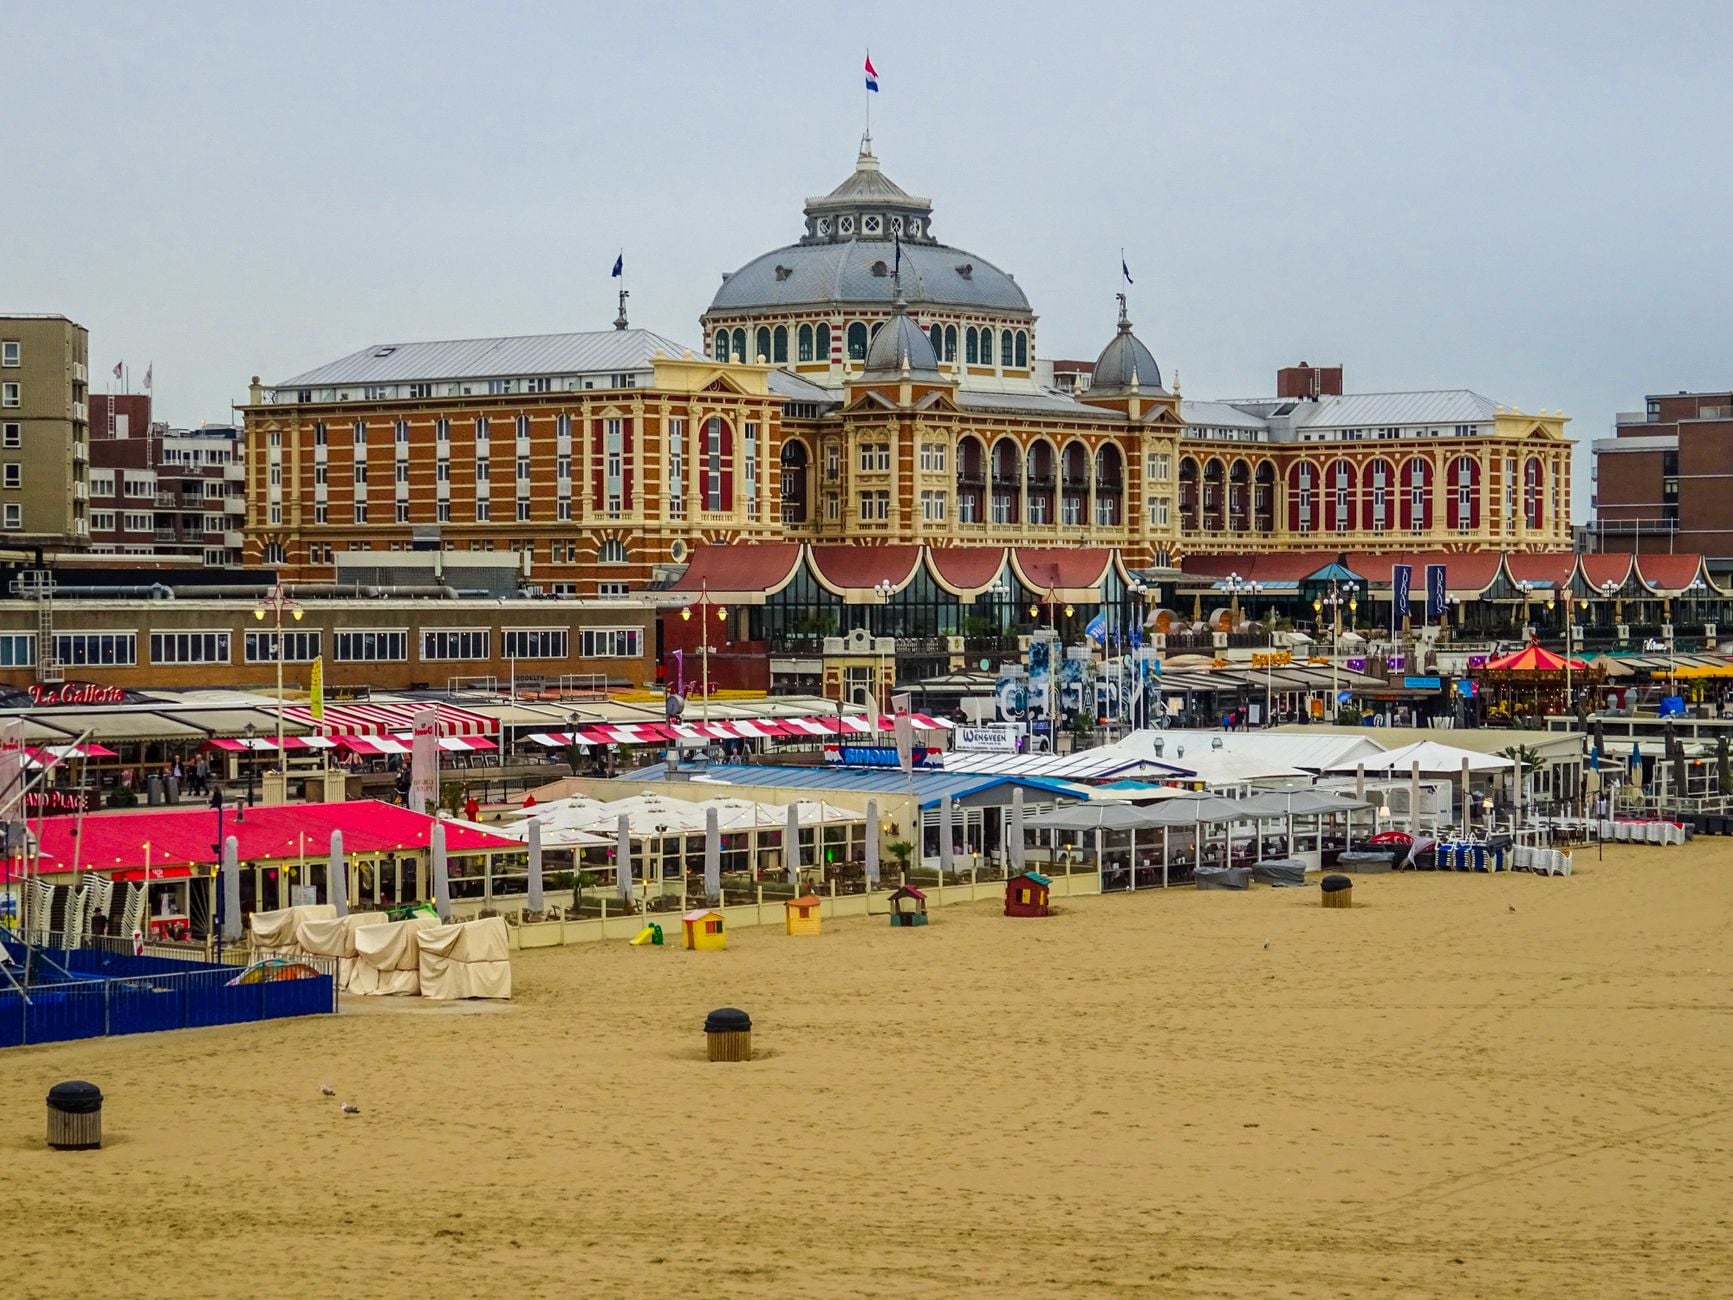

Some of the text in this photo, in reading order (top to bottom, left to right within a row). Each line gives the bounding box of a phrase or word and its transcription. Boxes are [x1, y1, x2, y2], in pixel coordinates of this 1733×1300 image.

[28, 683, 124, 704] La Galleria
[844, 747, 900, 766] SIMONI
